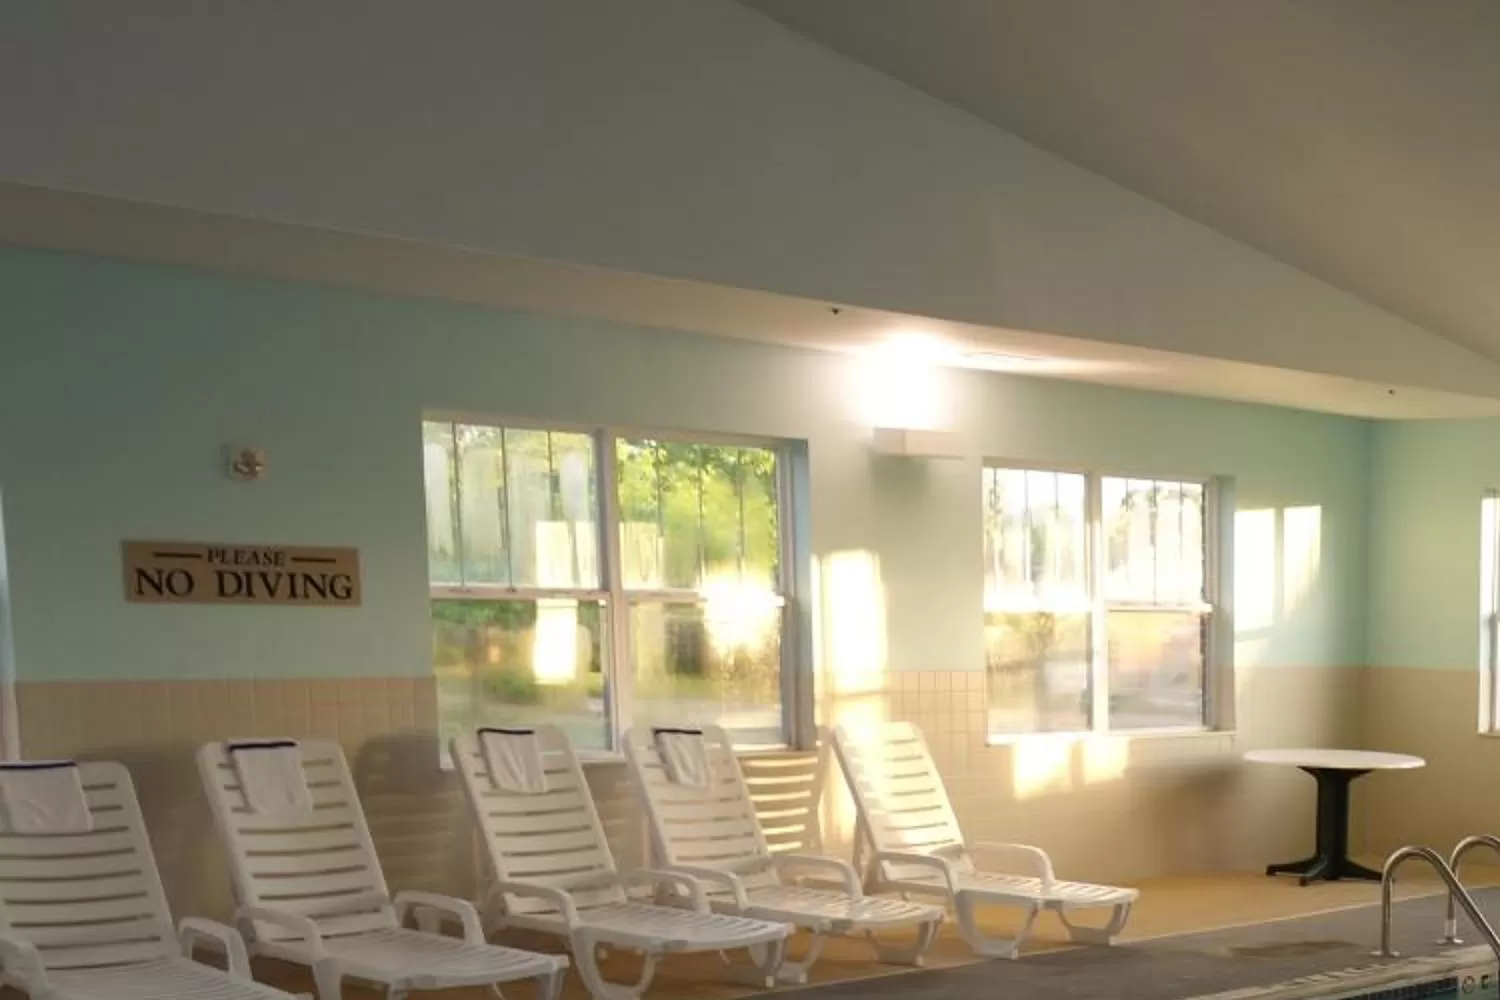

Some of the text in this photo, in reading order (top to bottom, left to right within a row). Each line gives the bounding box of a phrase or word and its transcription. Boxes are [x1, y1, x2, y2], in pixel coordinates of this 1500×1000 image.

[206, 548, 287, 567] PLEASE
[134, 567, 353, 600] NO DIVING
